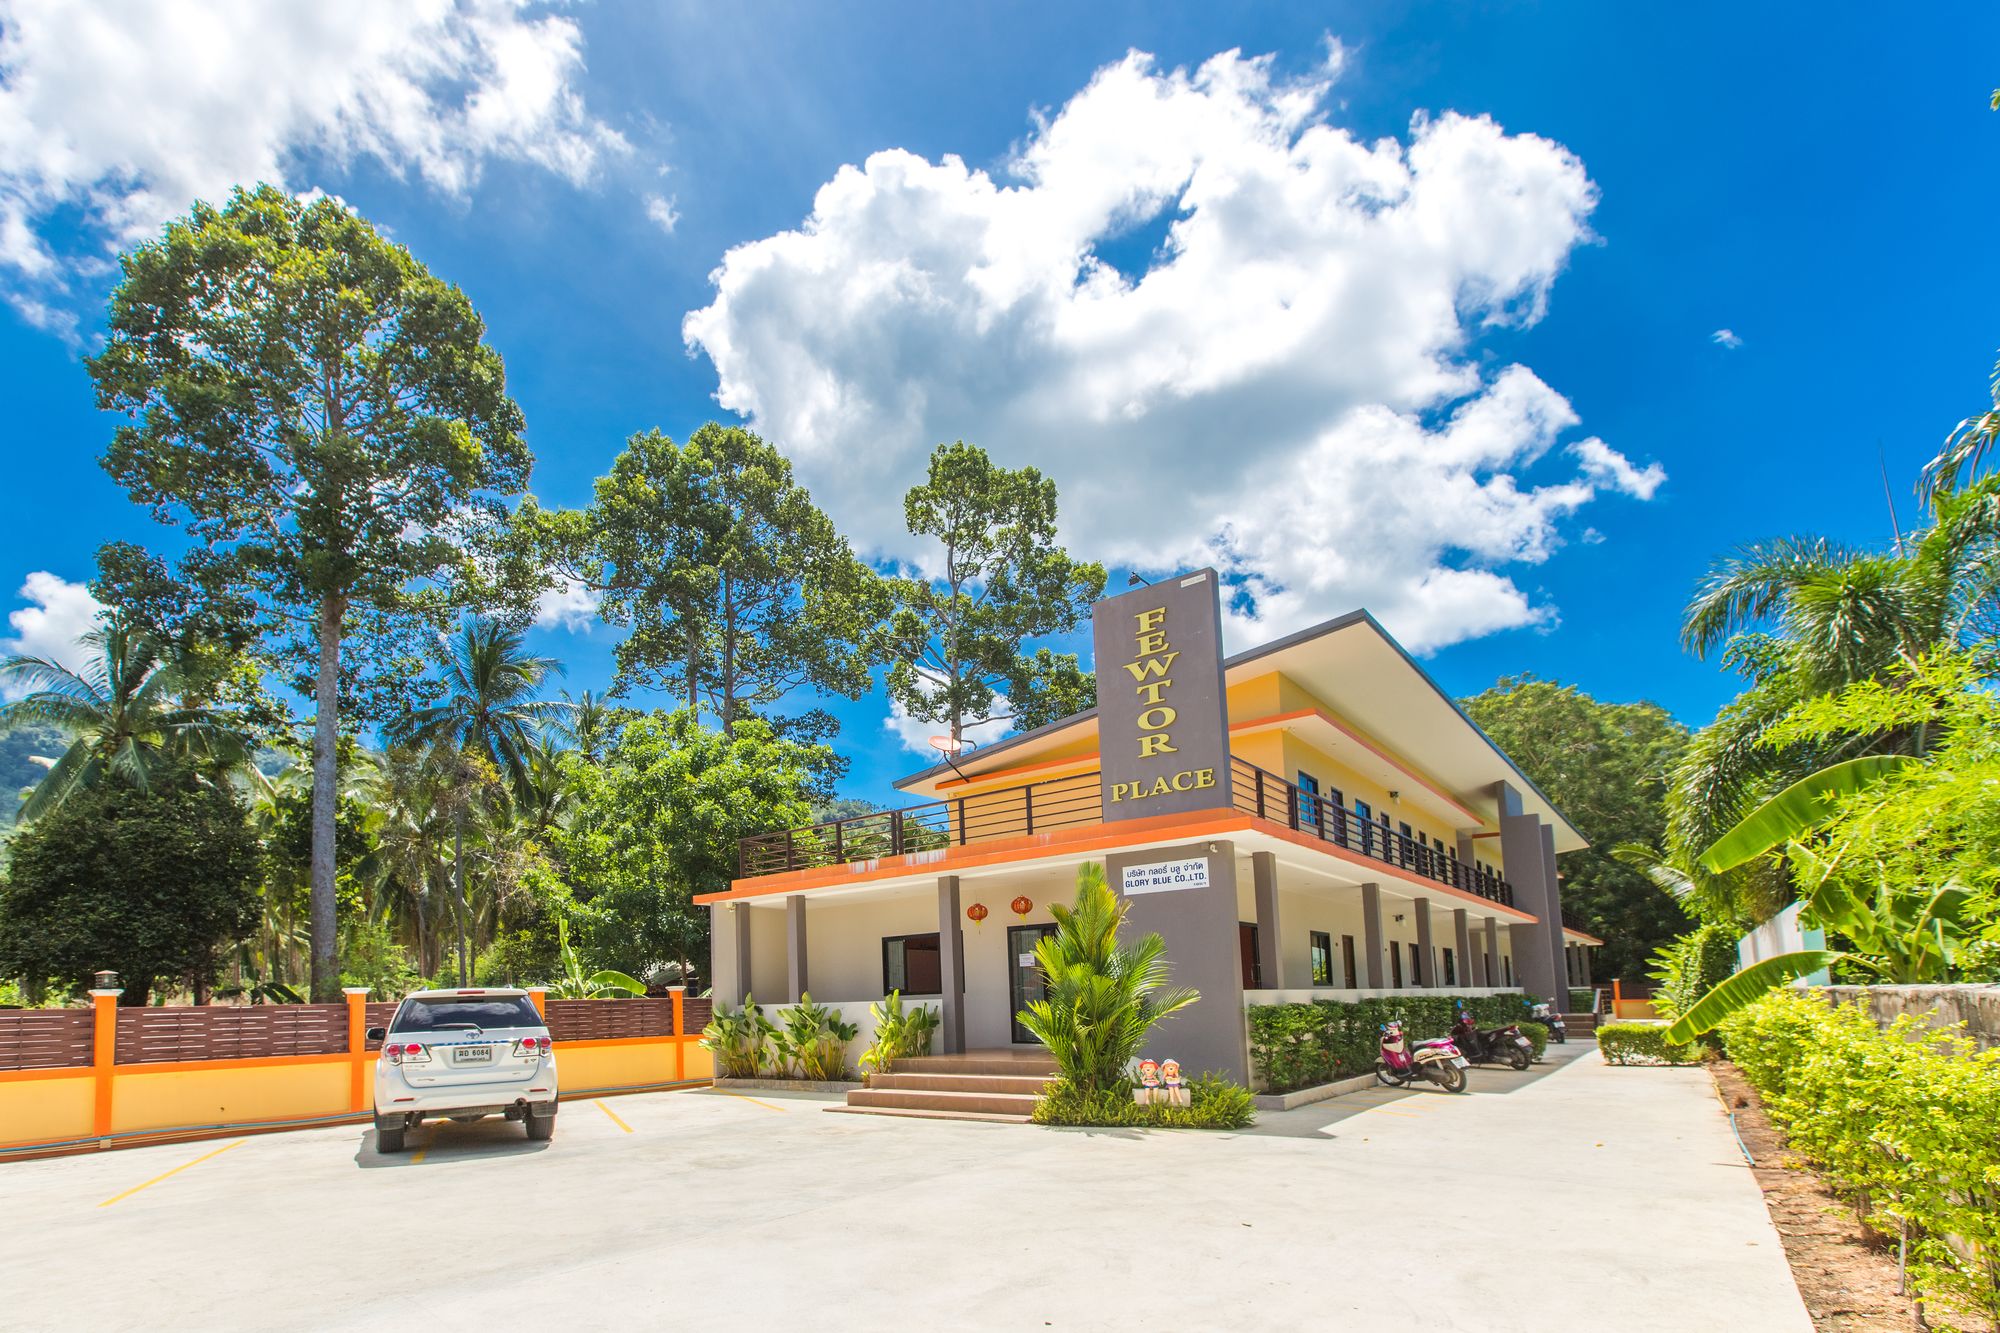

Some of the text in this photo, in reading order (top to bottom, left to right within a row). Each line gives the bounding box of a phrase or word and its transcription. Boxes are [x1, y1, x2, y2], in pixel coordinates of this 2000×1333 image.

[1122, 606, 1180, 759] FEWTOR
[1110, 768, 1216, 802] PLACE
[1126, 869, 1146, 878] บริษัท
[1125, 879, 1150, 888] GLORY
[1152, 876, 1172, 885] BLUE
[472, 1049, 489, 1057] 6084
